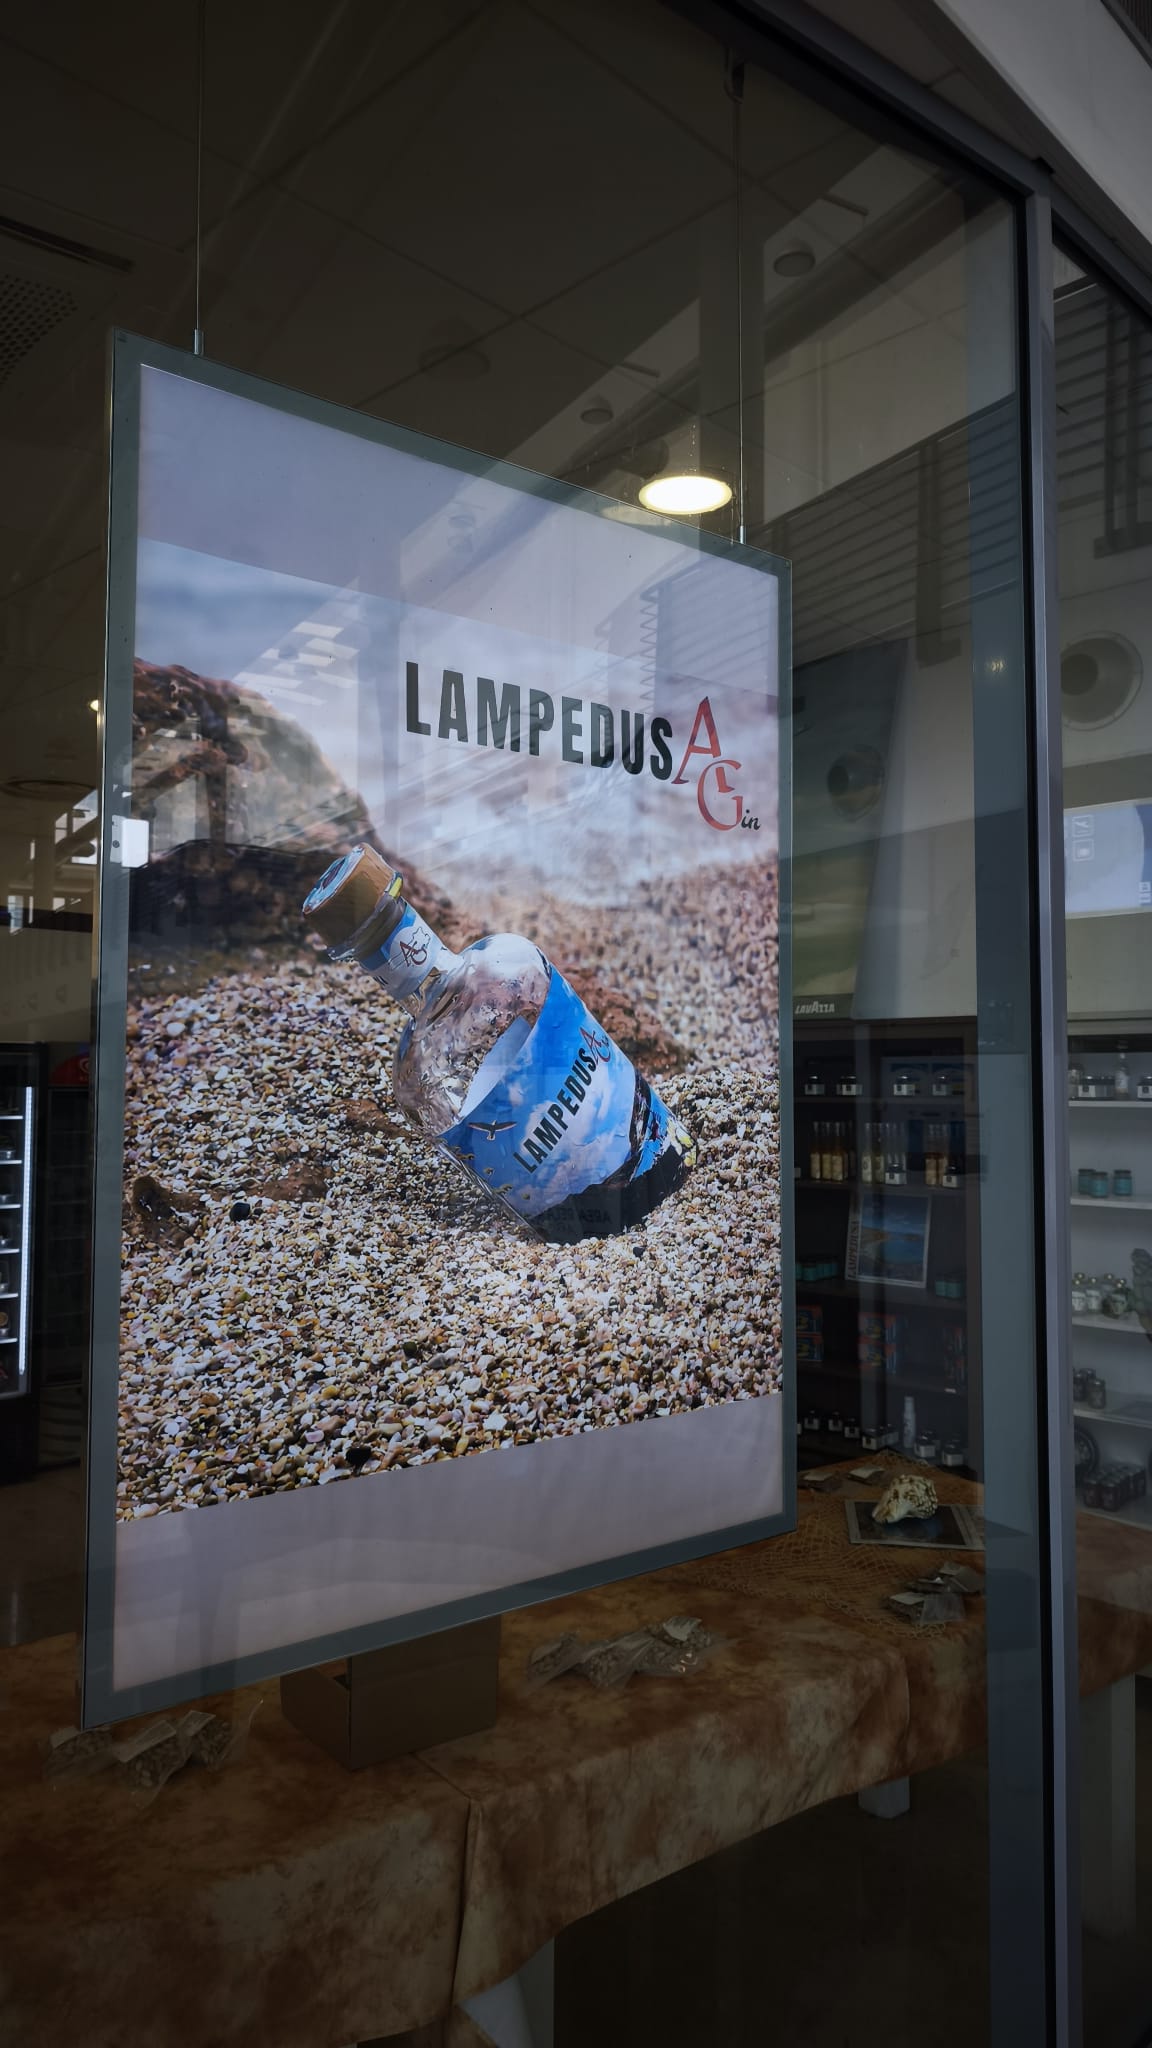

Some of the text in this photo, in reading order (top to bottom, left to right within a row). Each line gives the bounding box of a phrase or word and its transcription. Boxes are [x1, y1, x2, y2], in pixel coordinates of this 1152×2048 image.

[406, 661, 735, 793] LAMPEDUSA
[697, 759, 760, 831] Gin
[794, 1000, 835, 1015] LAVAZZA
[512, 1026, 602, 1174] LAMPEDUSA
